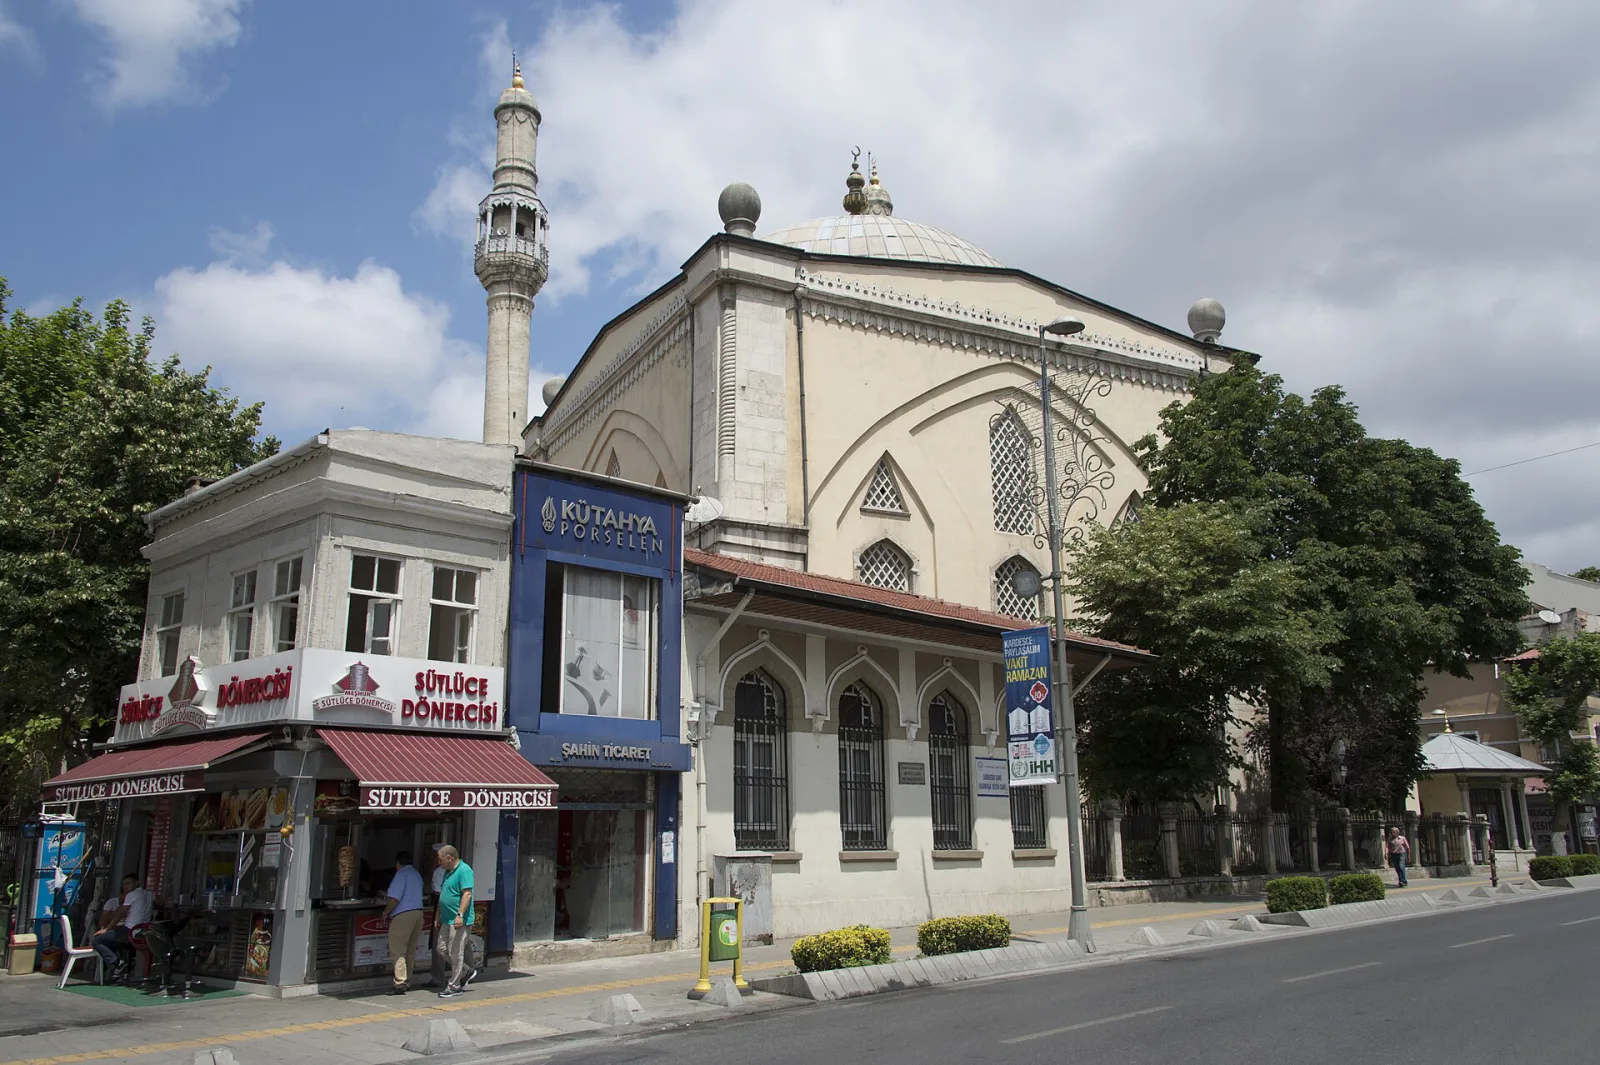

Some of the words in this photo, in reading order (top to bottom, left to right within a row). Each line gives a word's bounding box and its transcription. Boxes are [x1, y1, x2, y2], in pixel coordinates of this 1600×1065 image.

[562, 499, 658, 537] KÜTAHYA
[561, 521, 663, 553] PORSELEN
[216, 665, 293, 708] DÖNERCİSİ
[415, 669, 488, 696] SÜTLÜCE
[1006, 666, 1047, 683] RAMAZAN
[321, 697, 353, 707] SÜTLÜCE
[355, 697, 393, 711] DÖNERCİSİ
[402, 696, 497, 723] DÖNERCİSİ
[562, 741, 600, 758] ŞAHİN
[602, 743, 652, 759] TİCARET
[55, 782, 107, 801] SÜTLÜCE
[110, 774, 185, 797] DÖNERCİSİ
[368, 787, 451, 807] SÜTLÜCE
[463, 788, 552, 807] DÖNERCİSİ
